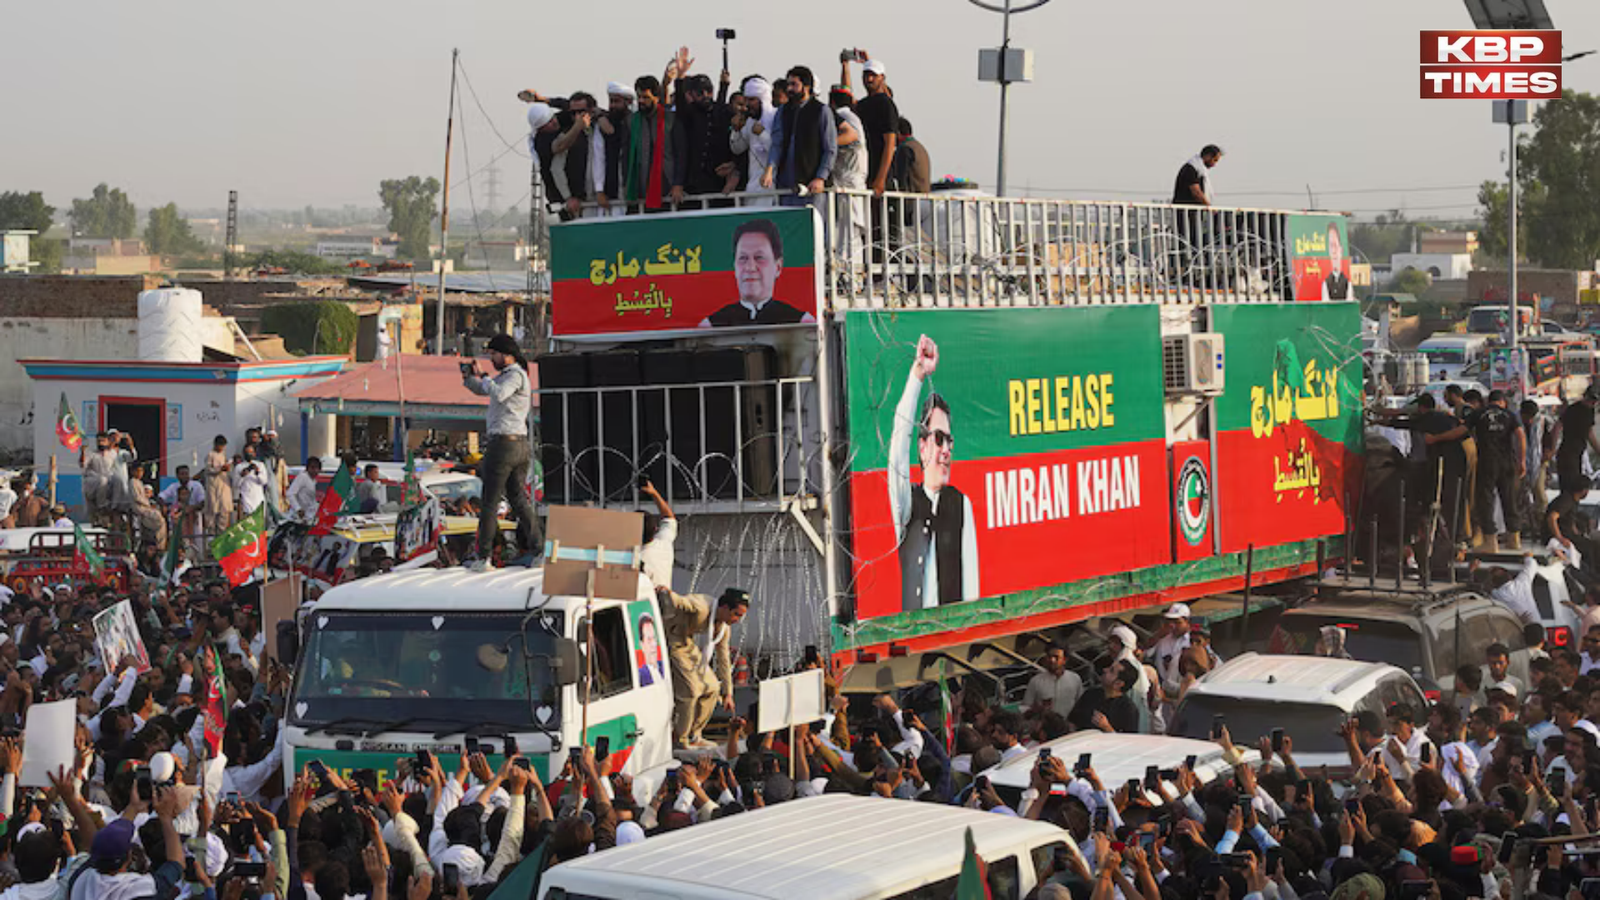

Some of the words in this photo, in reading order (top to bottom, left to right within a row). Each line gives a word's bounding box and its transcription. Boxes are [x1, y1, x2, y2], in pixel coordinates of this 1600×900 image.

[590, 250, 640, 286] مارچ
[644, 241, 701, 275] لانگ
[1008, 373, 1115, 436] RELEASE
[1251, 370, 1292, 438] مارچ
[1296, 359, 1339, 420] لانگ
[985, 463, 1070, 530] IMRAN
[1077, 455, 1141, 515] KHAN
